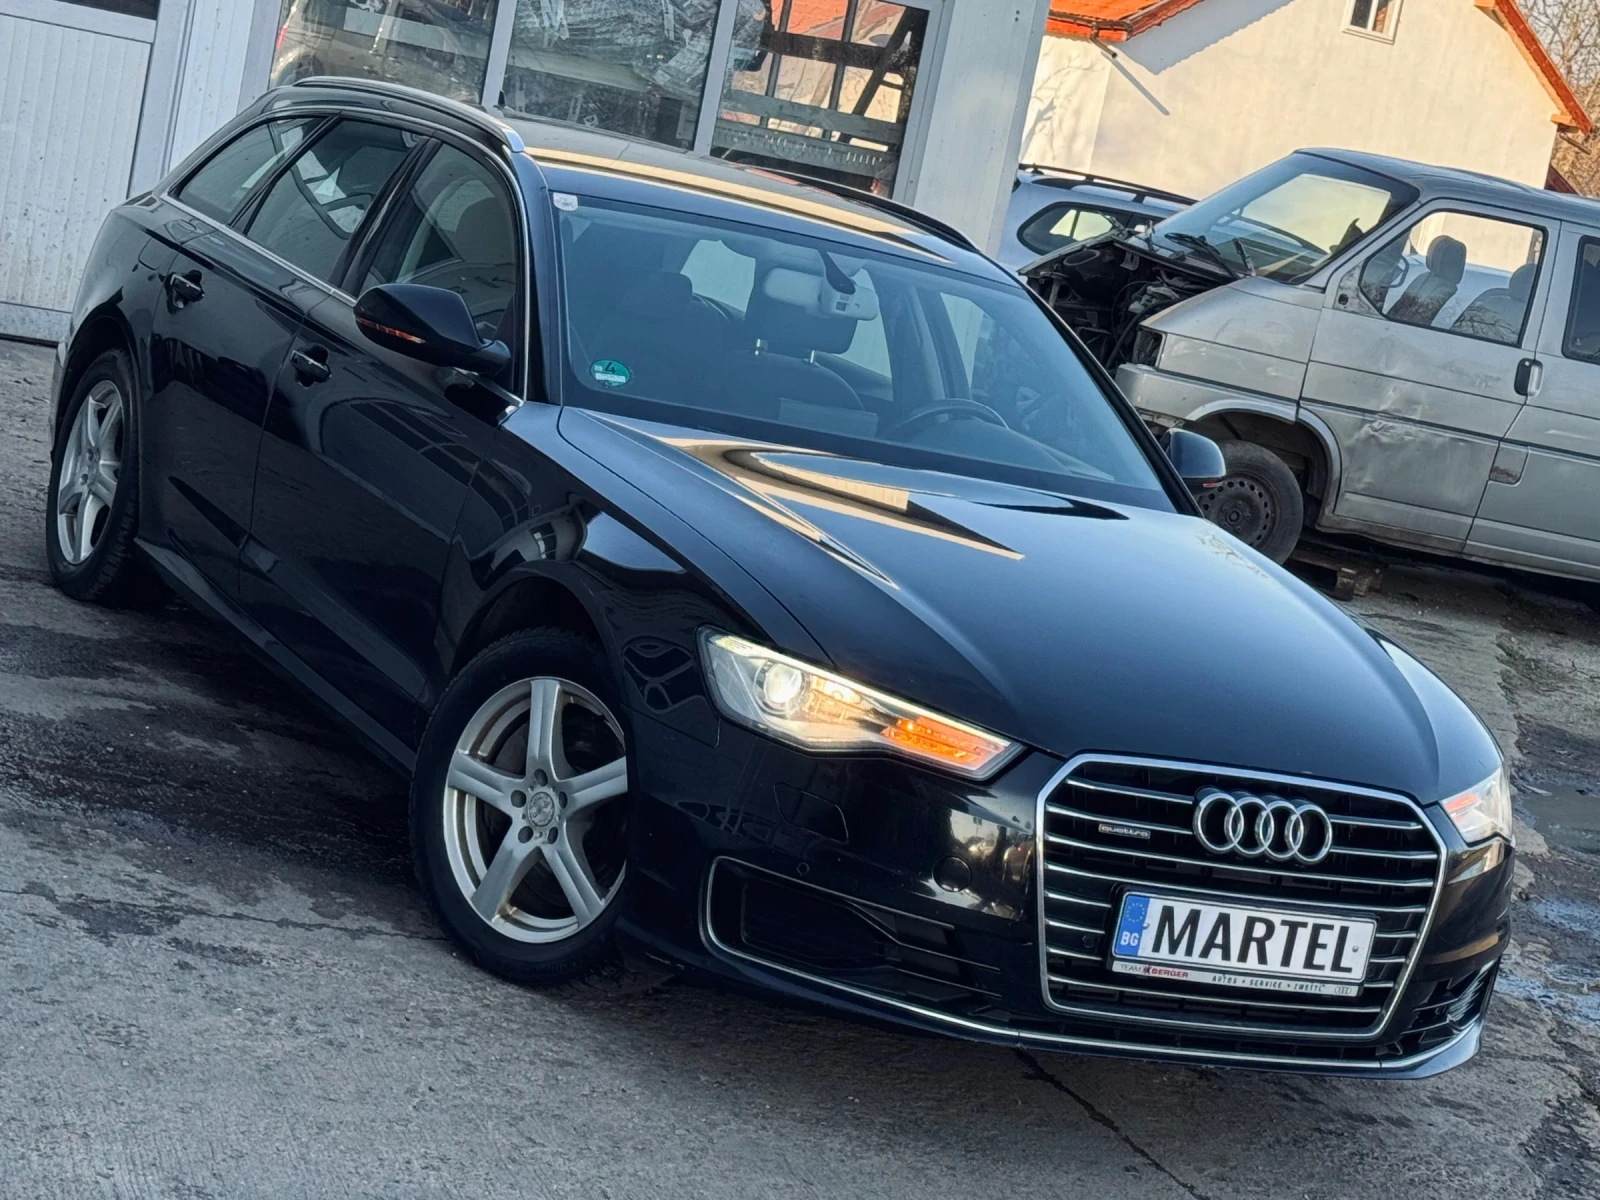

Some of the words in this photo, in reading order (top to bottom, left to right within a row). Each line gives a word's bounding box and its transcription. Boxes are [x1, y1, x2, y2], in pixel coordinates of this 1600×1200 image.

[604, 361, 616, 374] 4
[1101, 825, 1148, 838] quattro
[1120, 931, 1139, 947] BG
[1152, 905, 1353, 973] MARTEL
[1151, 968, 1189, 979] BERGER
[1249, 979, 1283, 989] SERVICE
